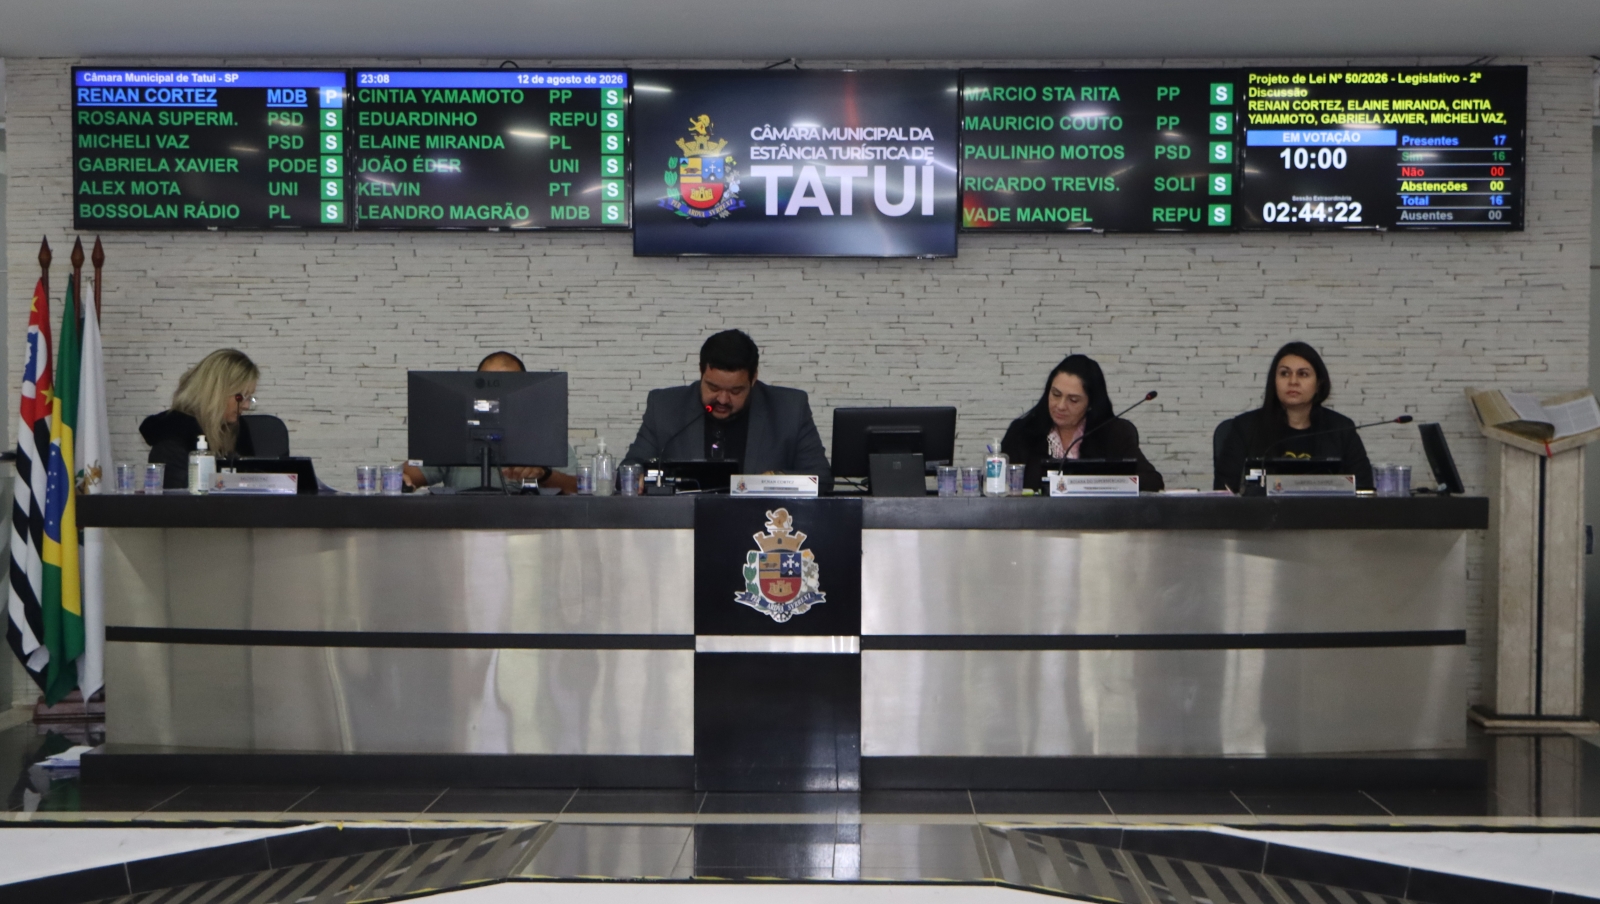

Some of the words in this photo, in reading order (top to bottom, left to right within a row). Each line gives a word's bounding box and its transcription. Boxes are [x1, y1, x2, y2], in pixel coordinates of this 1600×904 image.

[84, 73, 122, 82] Câmara
[125, 73, 174, 83] Municipal
[176, 74, 189, 82] de
[192, 74, 216, 83] Tatuí
[225, 74, 239, 83] SP
[361, 75, 389, 84] 23:08
[518, 75, 529, 84] 12
[532, 75, 544, 84] de
[547, 75, 582, 85] agosto
[584, 75, 597, 84] de
[599, 75, 623, 84] 2026
[1249, 74, 1289, 85] Projeto
[1292, 74, 1306, 83] de
[1309, 74, 1325, 83] Lei
[1345, 74, 1388, 84] 50/2026
[1398, 74, 1459, 85] Legislativo
[78, 89, 139, 102] RENAN
[147, 89, 217, 103] CORTEZ
[267, 89, 307, 103] MDB
[326, 90, 337, 104] P
[359, 90, 417, 104] CINTIA
[421, 90, 524, 104] YAMAMOTO
[549, 90, 572, 104] PP
[606, 91, 618, 105] S
[965, 87, 1037, 101] MARCIO
[1042, 87, 1075, 101] STA
[1081, 87, 1120, 101] RITA
[1157, 87, 1180, 100] PP
[1216, 87, 1227, 101] S
[1249, 87, 1308, 98] Discussão
[1249, 100, 1289, 111] RENAN
[1292, 100, 1344, 112] CORTEZ,
[1348, 100, 1389, 110] ELAINE
[1392, 100, 1449, 112] MIRANDA,
[1452, 100, 1491, 110] CINTIA
[78, 112, 153, 126] ROSANA
[158, 112, 238, 126] SUPERM.
[268, 112, 304, 126] PSD
[325, 113, 337, 127] S
[359, 112, 477, 126] EDUARDINHO
[550, 113, 597, 127] REPU
[606, 113, 618, 127] S
[965, 116, 1054, 130] MAURICIO
[1059, 116, 1123, 131] COUTO
[1157, 116, 1179, 130] PP
[1215, 116, 1227, 130] S
[1249, 114, 1318, 126] YAMAMOTO,
[1321, 114, 1381, 124] GABRIELA
[1383, 113, 1428, 125] XAVIER,
[1431, 113, 1479, 124] MICHELI
[1481, 113, 1507, 125] VAZ,
[751, 124, 820, 141] CÂMARA
[823, 127, 908, 141] MUNICIPAL
[910, 127, 934, 141] DA
[1283, 133, 1300, 142] EM
[1302, 131, 1361, 144] VOTAÇÃO
[78, 135, 150, 149] MICHELI
[155, 135, 189, 149] VAZ
[268, 135, 304, 149] PSD
[325, 136, 337, 150] S
[359, 135, 420, 149] ELAINE
[426, 135, 504, 149] MIRANDA
[550, 136, 571, 149] PL
[606, 136, 618, 150] S
[1402, 136, 1459, 146] Presentes
[1493, 136, 1506, 145] 17
[750, 143, 827, 160] ESTÂNCIA
[829, 143, 910, 160] TURÍSTICA
[911, 147, 934, 160] DE
[965, 145, 1055, 160] PAULINHO
[1060, 145, 1124, 160] MOTOS
[1155, 145, 1191, 160] PSD
[1215, 145, 1227, 160] S
[1402, 152, 1423, 161] Sim
[1493, 152, 1506, 161] 16
[79, 158, 170, 172] GABRIELA
[174, 158, 239, 172] XAVIER
[268, 159, 317, 173] PODE
[325, 159, 337, 173] S
[358, 155, 407, 173] JOÃO
[413, 155, 461, 173] ÉDER
[550, 159, 579, 173] UNI
[607, 159, 618, 173] S
[1280, 148, 1347, 170] 10:00
[1402, 167, 1424, 176] Não
[1491, 167, 1504, 176] 00
[79, 182, 125, 195] ALEX
[131, 182, 181, 195] MOTA
[269, 182, 298, 196] UNI
[326, 182, 337, 196] S
[358, 182, 420, 196] KELVIN
[550, 183, 571, 196] PT
[607, 183, 619, 197] S
[751, 159, 934, 216] TATUÍ
[965, 177, 1046, 191] RICARDO
[1052, 177, 1119, 191] TREVIS.
[1154, 177, 1195, 191] SOLI
[1214, 177, 1226, 191] S
[1401, 181, 1467, 192] Abstenções
[1490, 182, 1504, 191] 00
[1401, 196, 1430, 206] Total
[1490, 196, 1503, 205] 16
[79, 205, 178, 219] BOSSOLAN
[184, 201, 240, 219] RÁDIO
[269, 205, 290, 219] PL
[326, 205, 338, 219] S
[359, 205, 444, 220] LEANDRO
[450, 202, 529, 220] MAGRÃO
[551, 206, 590, 219] MDB
[607, 206, 619, 220] S
[964, 208, 1010, 222] VADE
[1017, 208, 1092, 222] MANOEL
[1153, 208, 1201, 222] REPU
[1214, 208, 1226, 222] S
[1263, 202, 1362, 222] 02:44:22
[1400, 211, 1453, 220] Ausentes
[1489, 211, 1502, 220] 00
